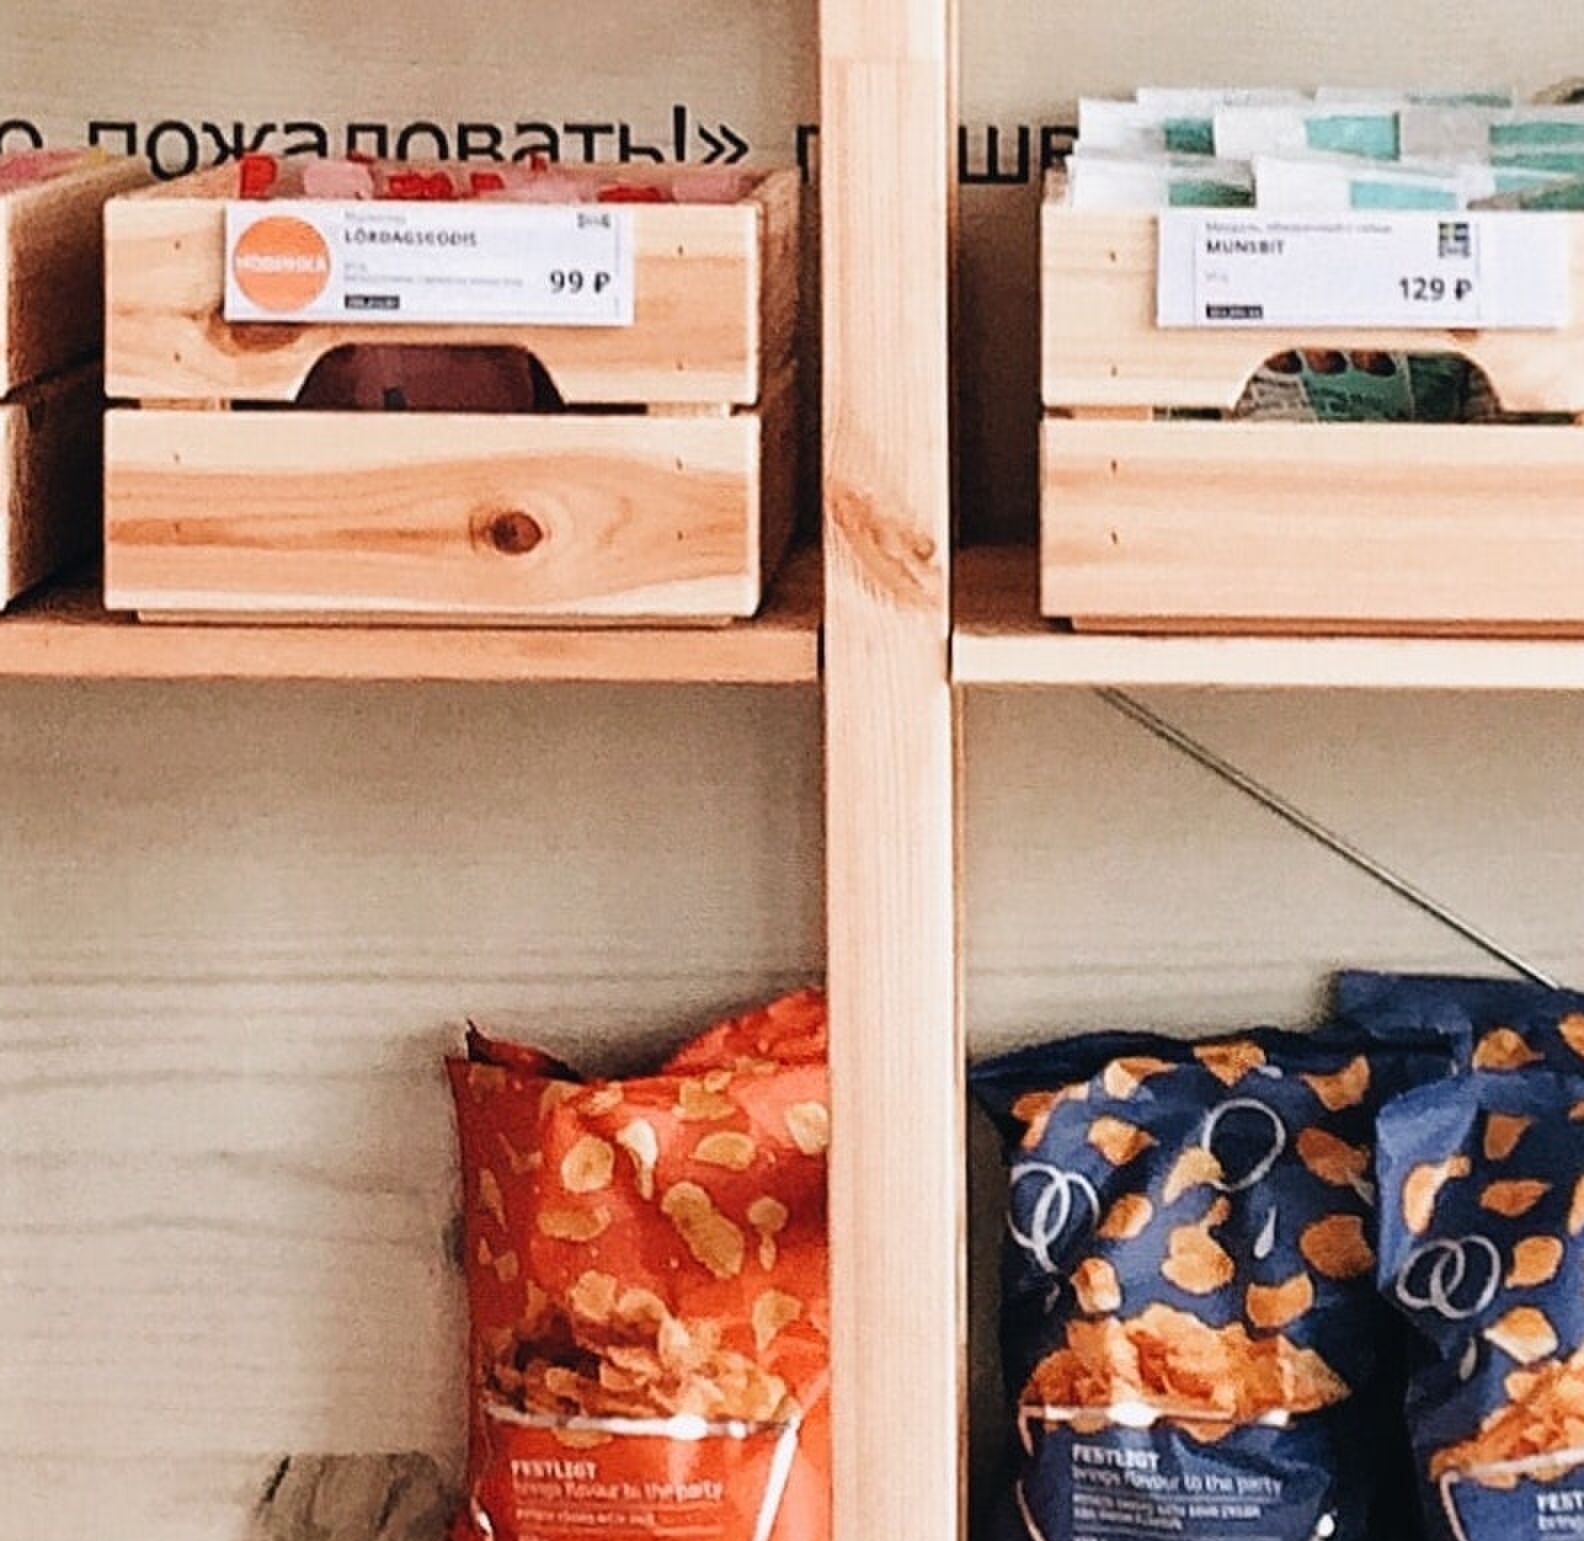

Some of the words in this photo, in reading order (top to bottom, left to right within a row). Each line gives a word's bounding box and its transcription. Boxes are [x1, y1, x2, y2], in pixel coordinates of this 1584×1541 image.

[1206, 239, 1285, 255] MUNSBIT
[549, 271, 584, 294] 99
[1399, 277, 1445, 301] 129
[1072, 1443, 1159, 1471] FESTLIGT
